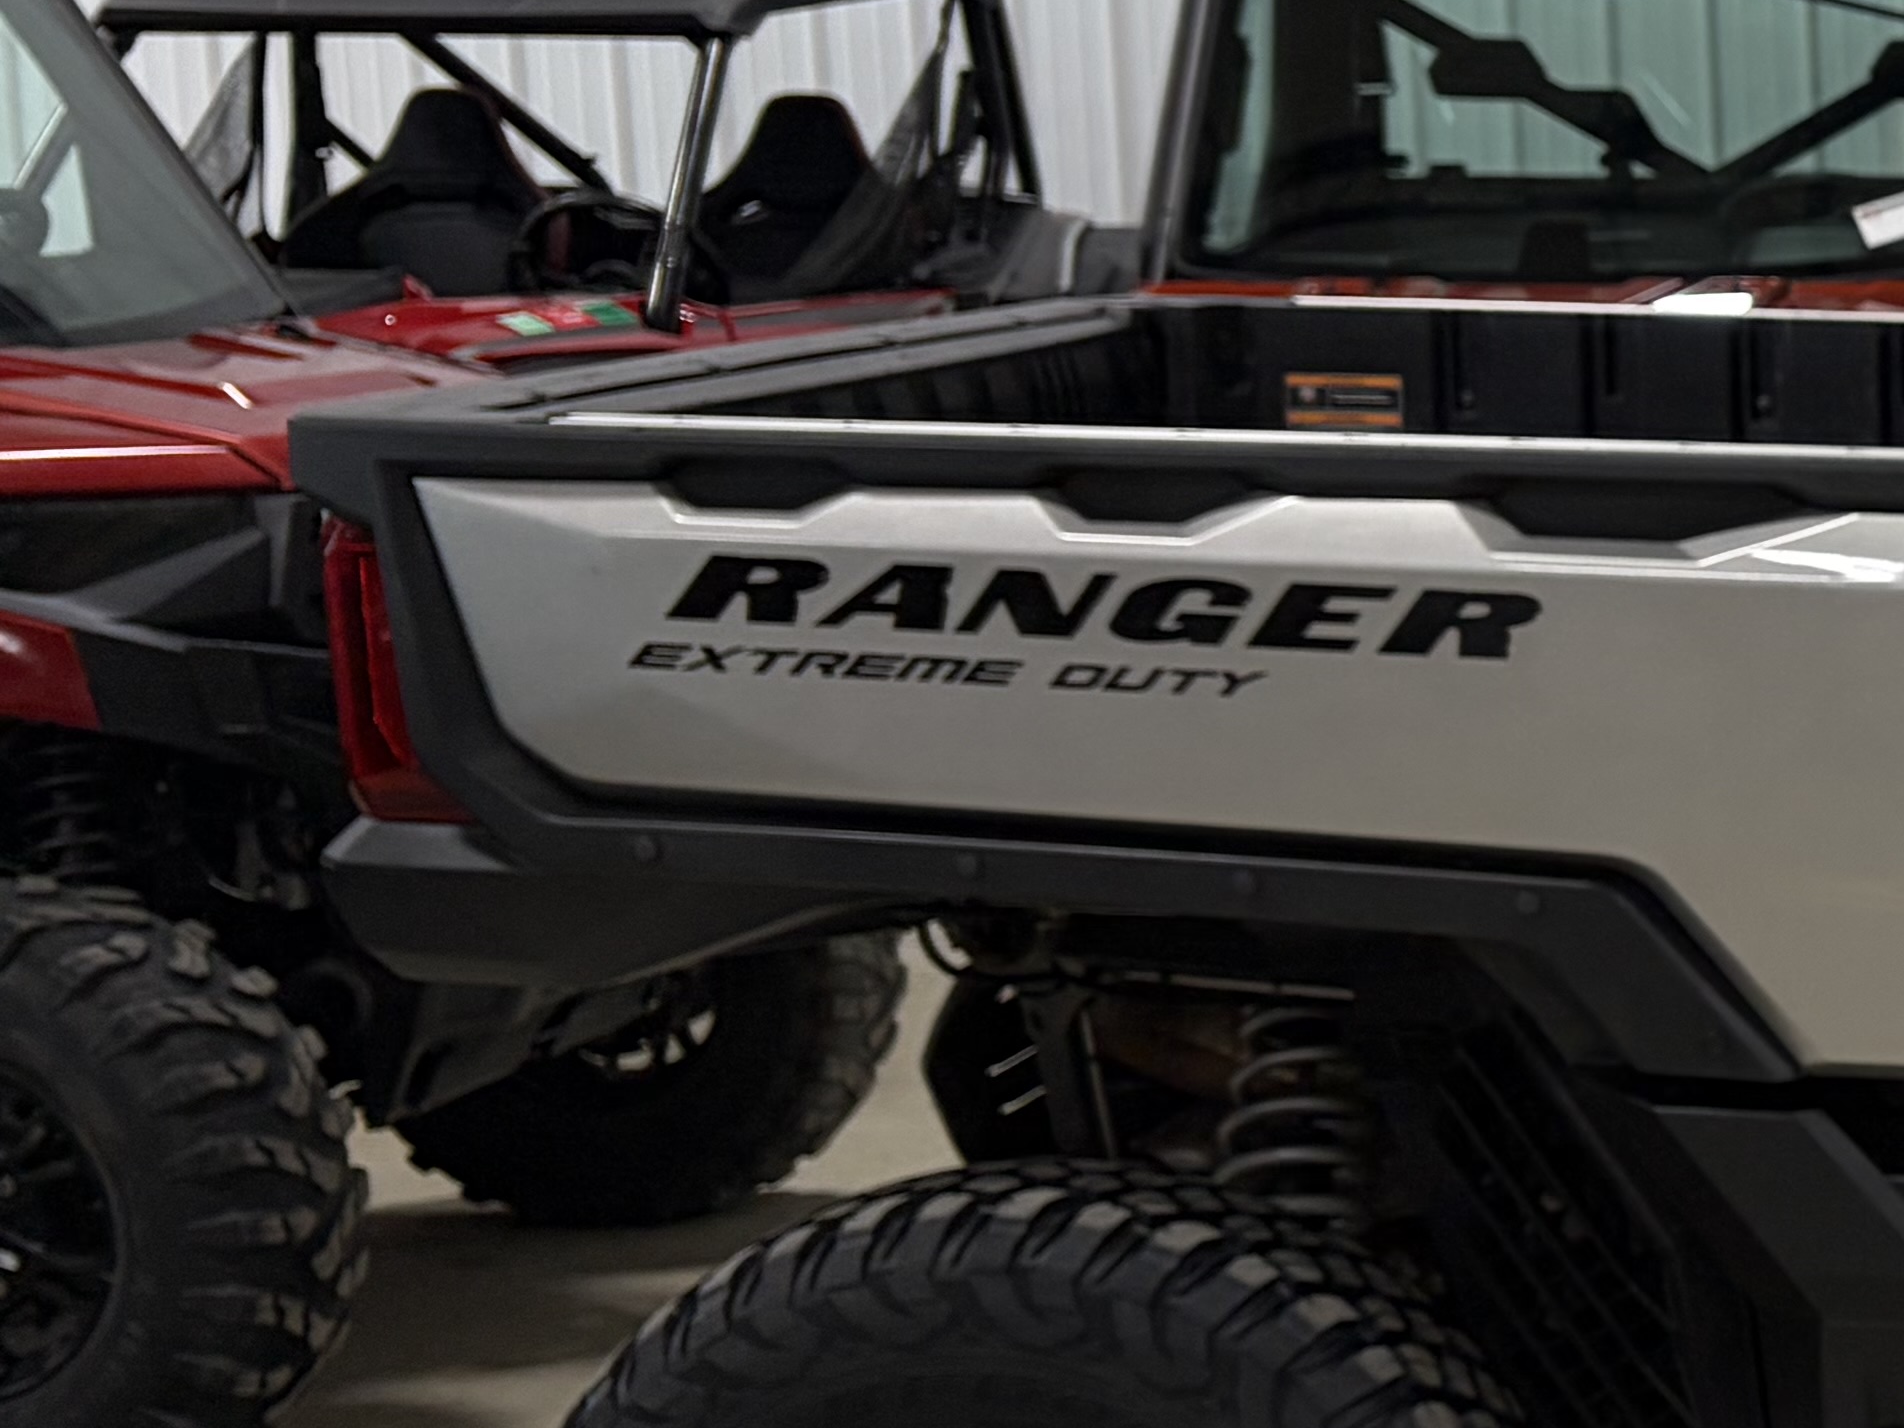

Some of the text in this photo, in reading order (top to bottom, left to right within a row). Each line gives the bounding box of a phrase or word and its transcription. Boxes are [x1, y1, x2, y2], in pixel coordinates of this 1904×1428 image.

[664, 553, 1543, 661] RANGER
[627, 641, 1270, 699] EXTREME DUTY
